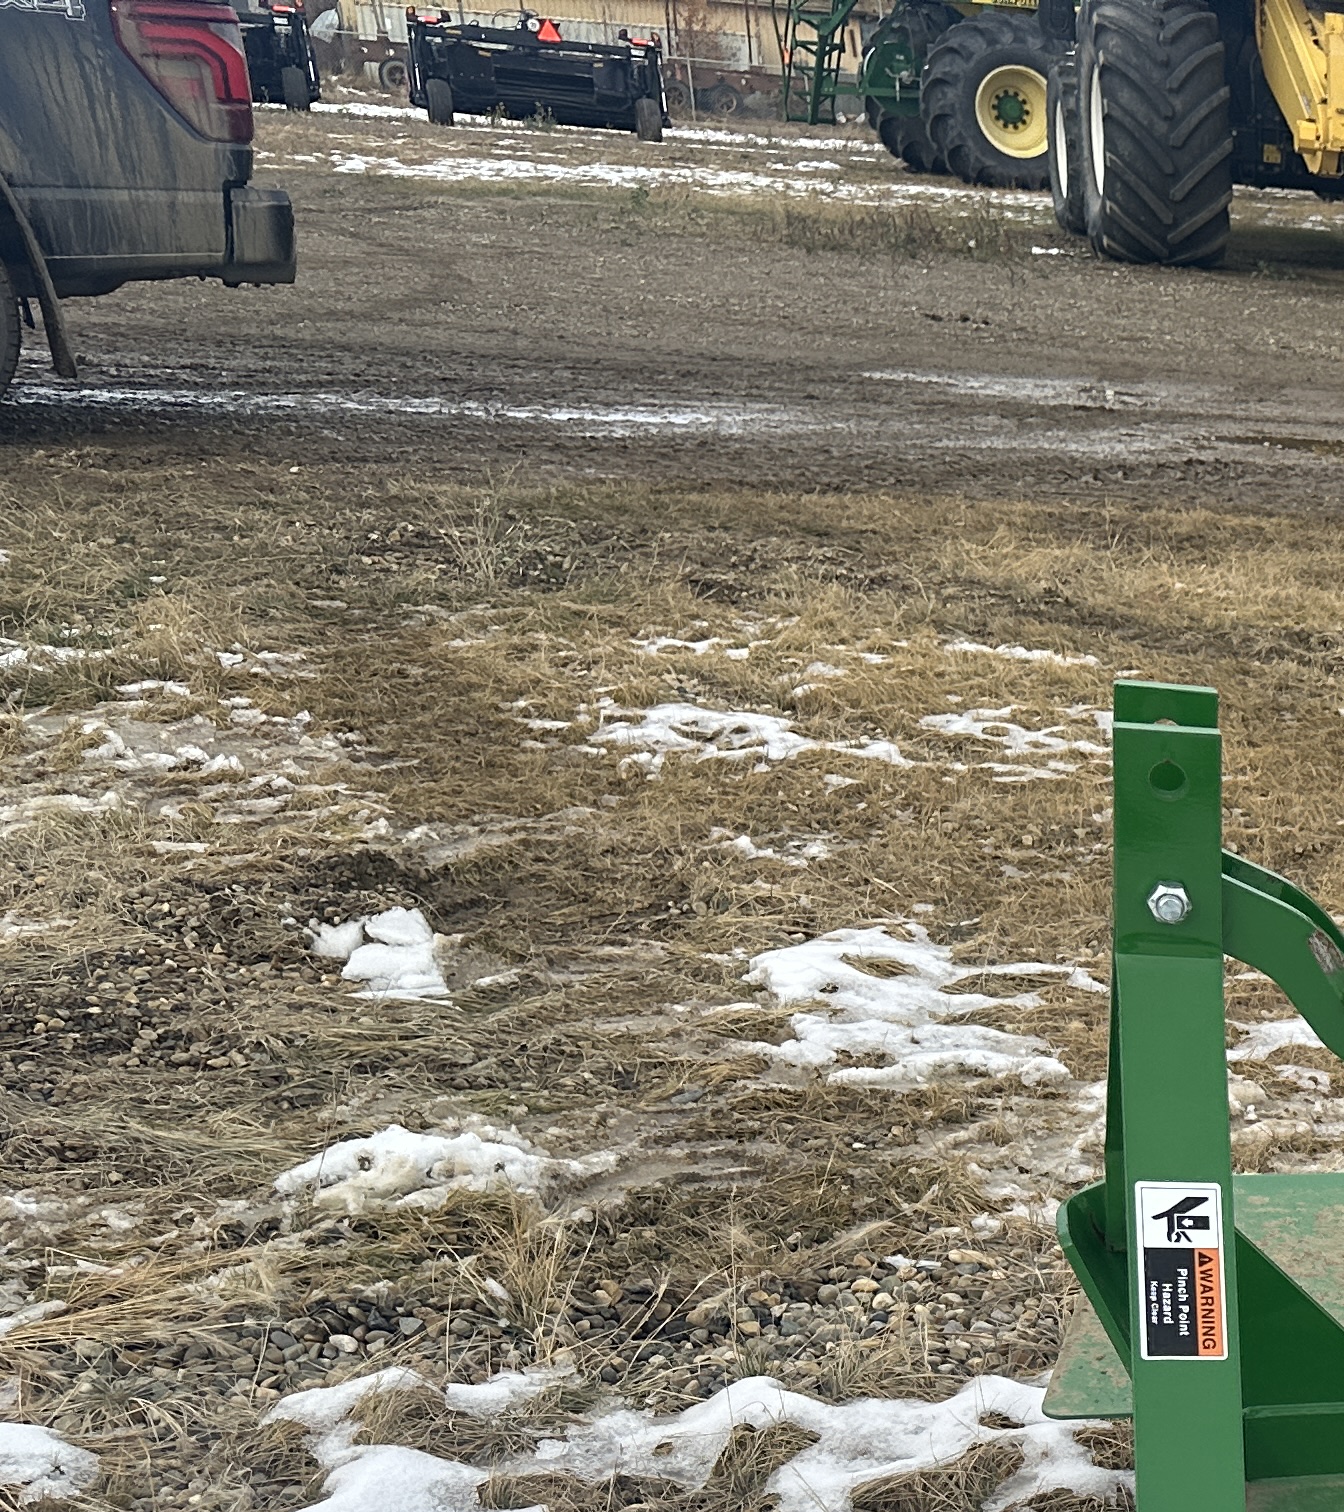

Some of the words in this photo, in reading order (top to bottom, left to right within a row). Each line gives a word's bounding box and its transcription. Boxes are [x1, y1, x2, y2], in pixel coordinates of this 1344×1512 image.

[1150, 1280, 1159, 1301] Keep
[1176, 1268, 1189, 1302] Pinch
[1162, 1283, 1174, 1324] Hazard
[1178, 1305, 1190, 1336] Point
[1198, 1268, 1217, 1350] WARNING
